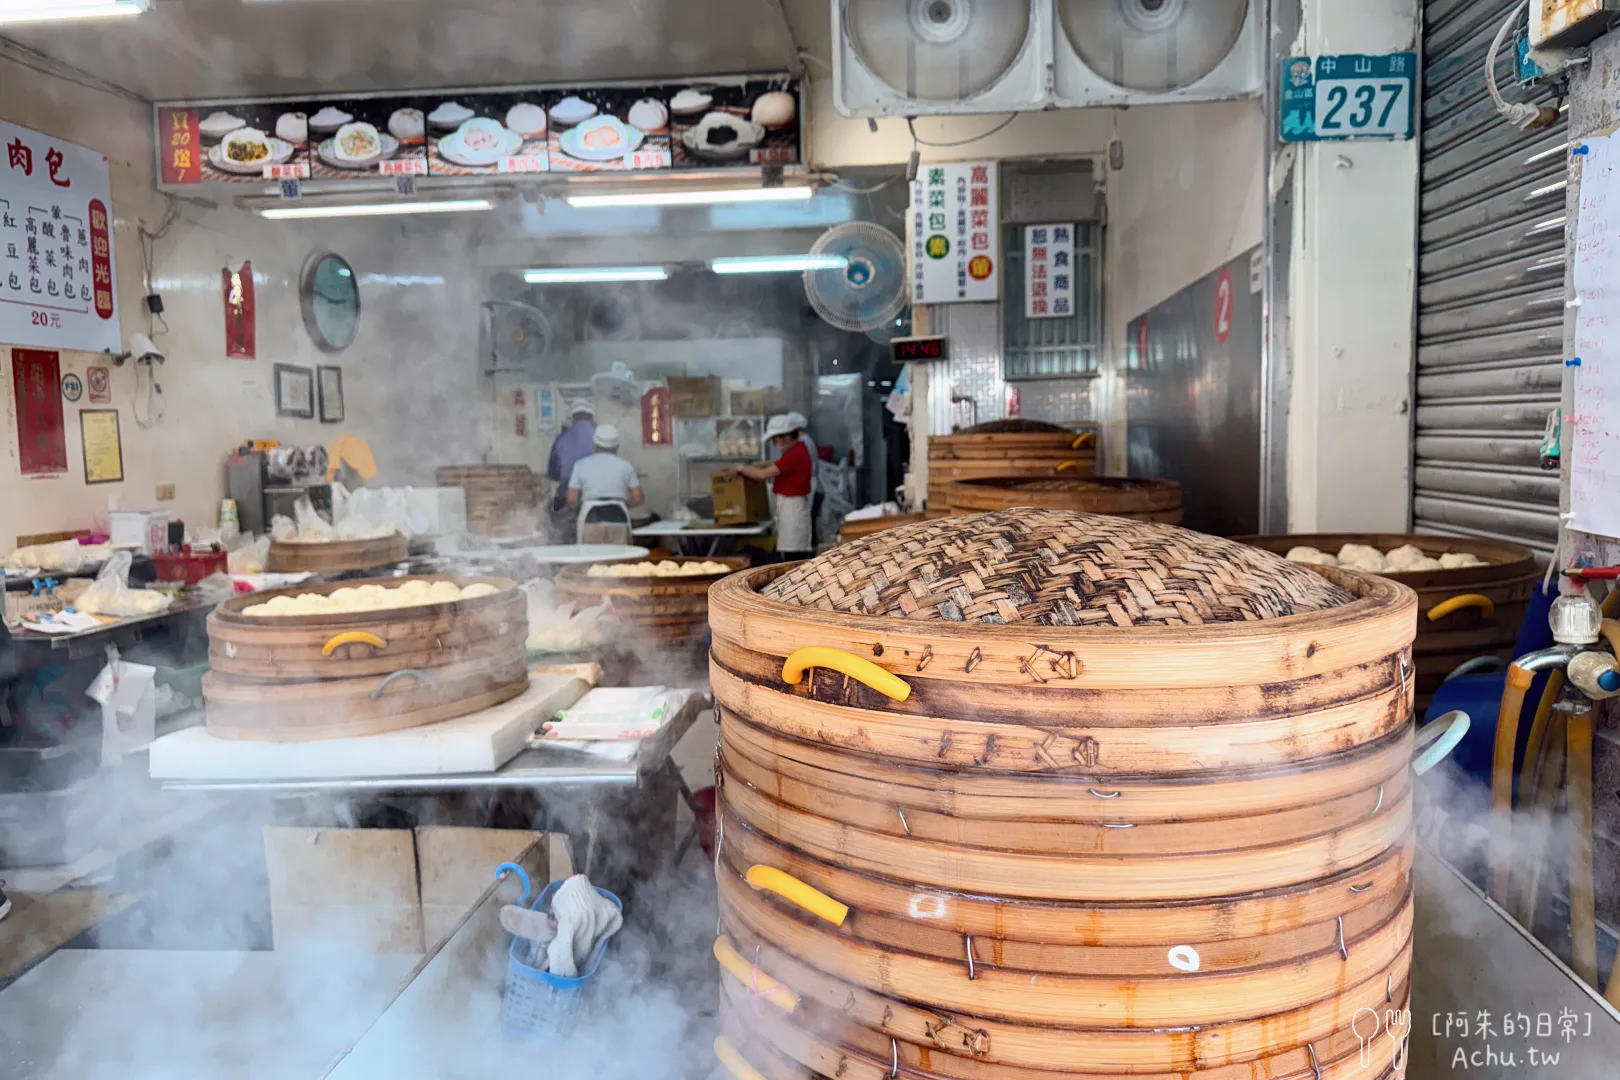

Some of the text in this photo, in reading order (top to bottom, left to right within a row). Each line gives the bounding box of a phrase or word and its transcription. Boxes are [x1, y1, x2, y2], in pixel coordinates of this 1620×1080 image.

[1321, 56, 1406, 75] 中山路
[1321, 84, 1404, 130] 237
[7, 136, 70, 188] 肉包
[928, 168, 946, 231] 素菜包
[970, 166, 989, 251] 高麗菜包
[3, 212, 21, 290] 紅豆包
[26, 216, 42, 293] 高麗菜包
[42, 221, 59, 296] 酸菜包
[92, 208, 111, 310] 歡迎光臨
[1031, 228, 1048, 315] 恕無法退換
[1053, 227, 1070, 314] 熱食商品
[31, 310, 61, 328] 20元
[1218, 278, 1230, 333] 2
